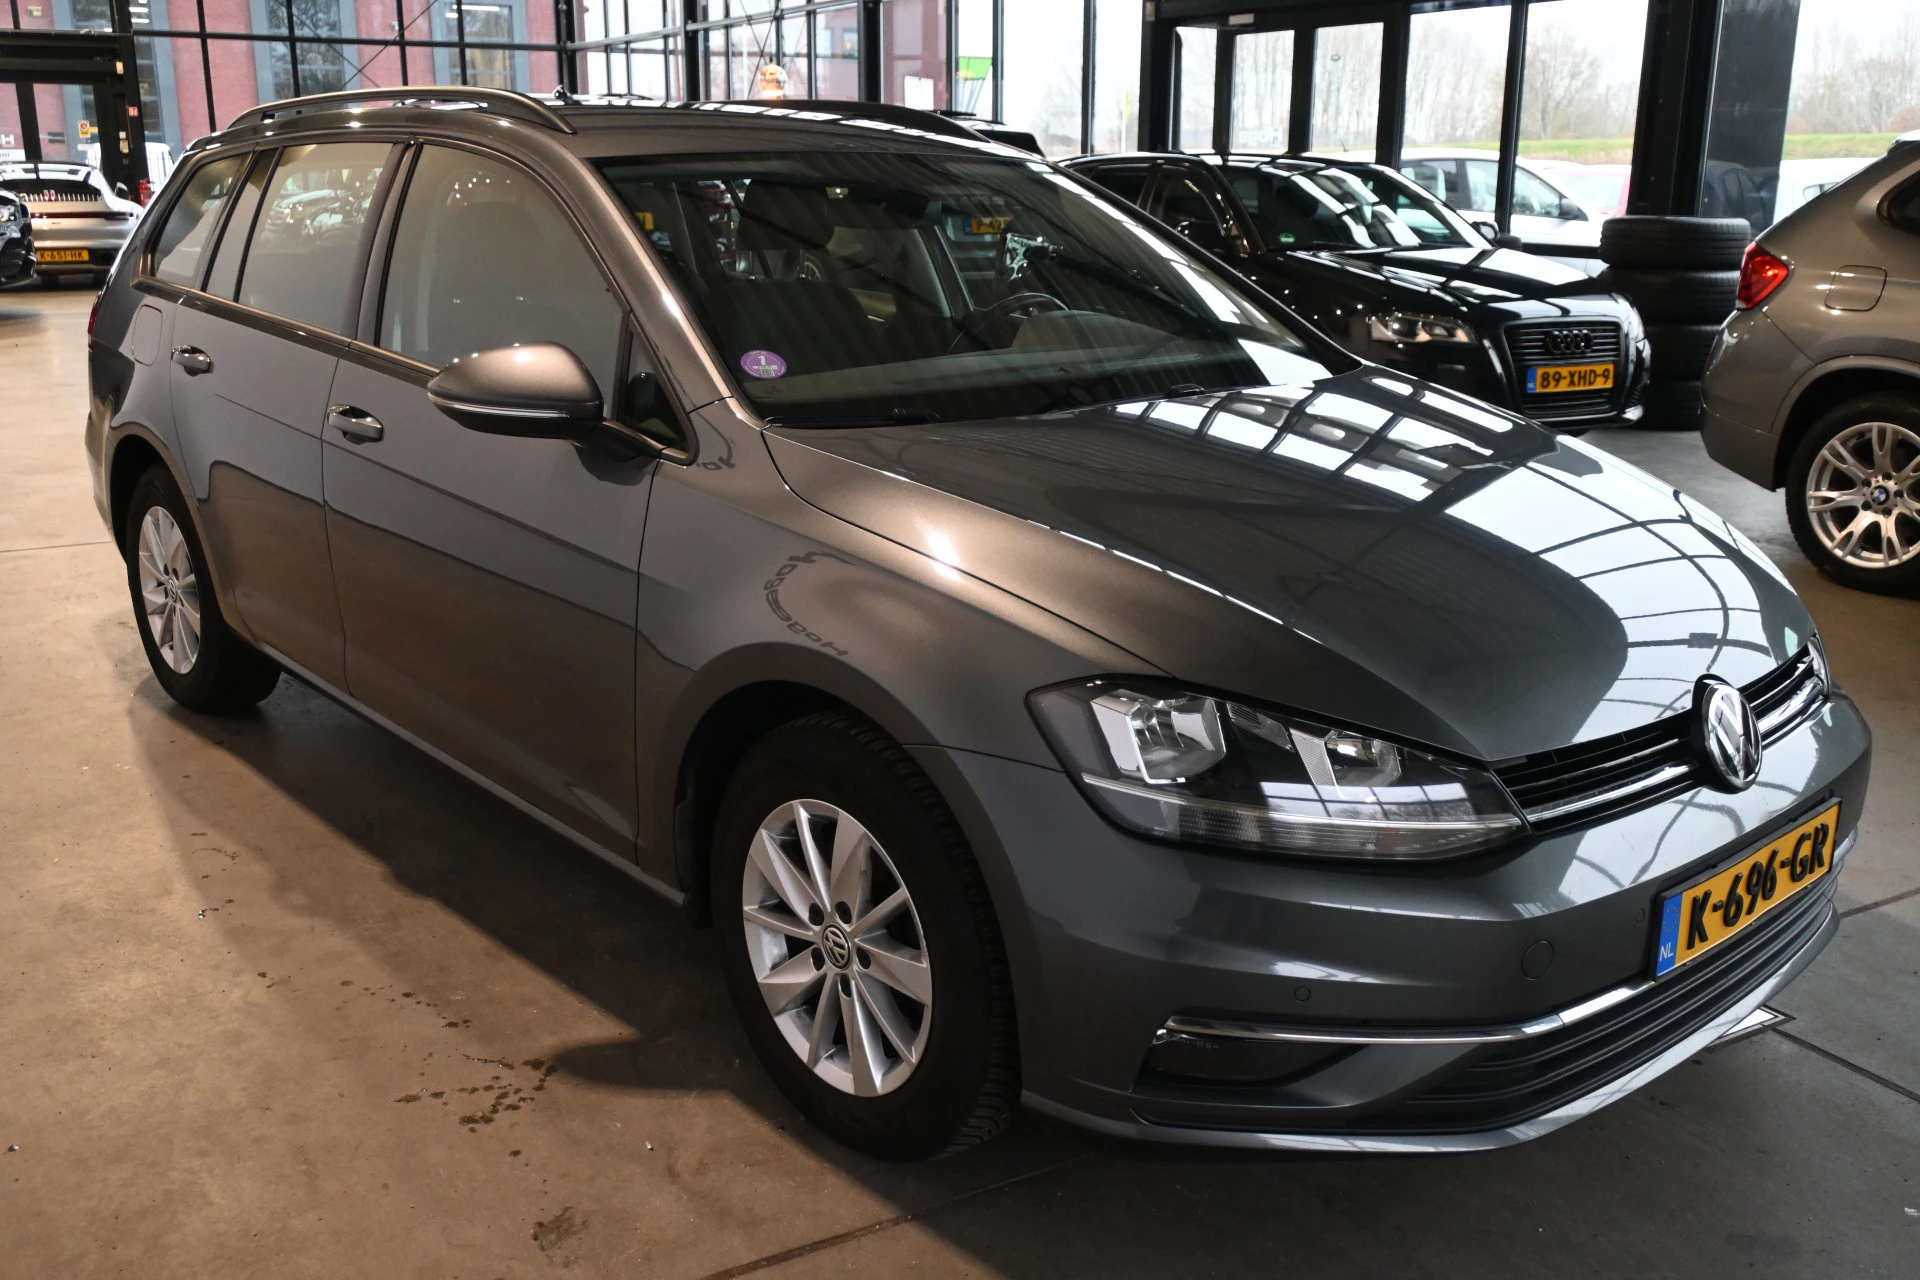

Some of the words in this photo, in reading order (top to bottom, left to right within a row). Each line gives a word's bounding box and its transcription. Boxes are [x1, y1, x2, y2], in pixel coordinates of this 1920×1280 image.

[757, 355, 766, 366] 1
[1540, 367, 1611, 389] 89-XHD-9
[1659, 942, 1674, 962] NL
[1686, 821, 1830, 951] K-696-GR
